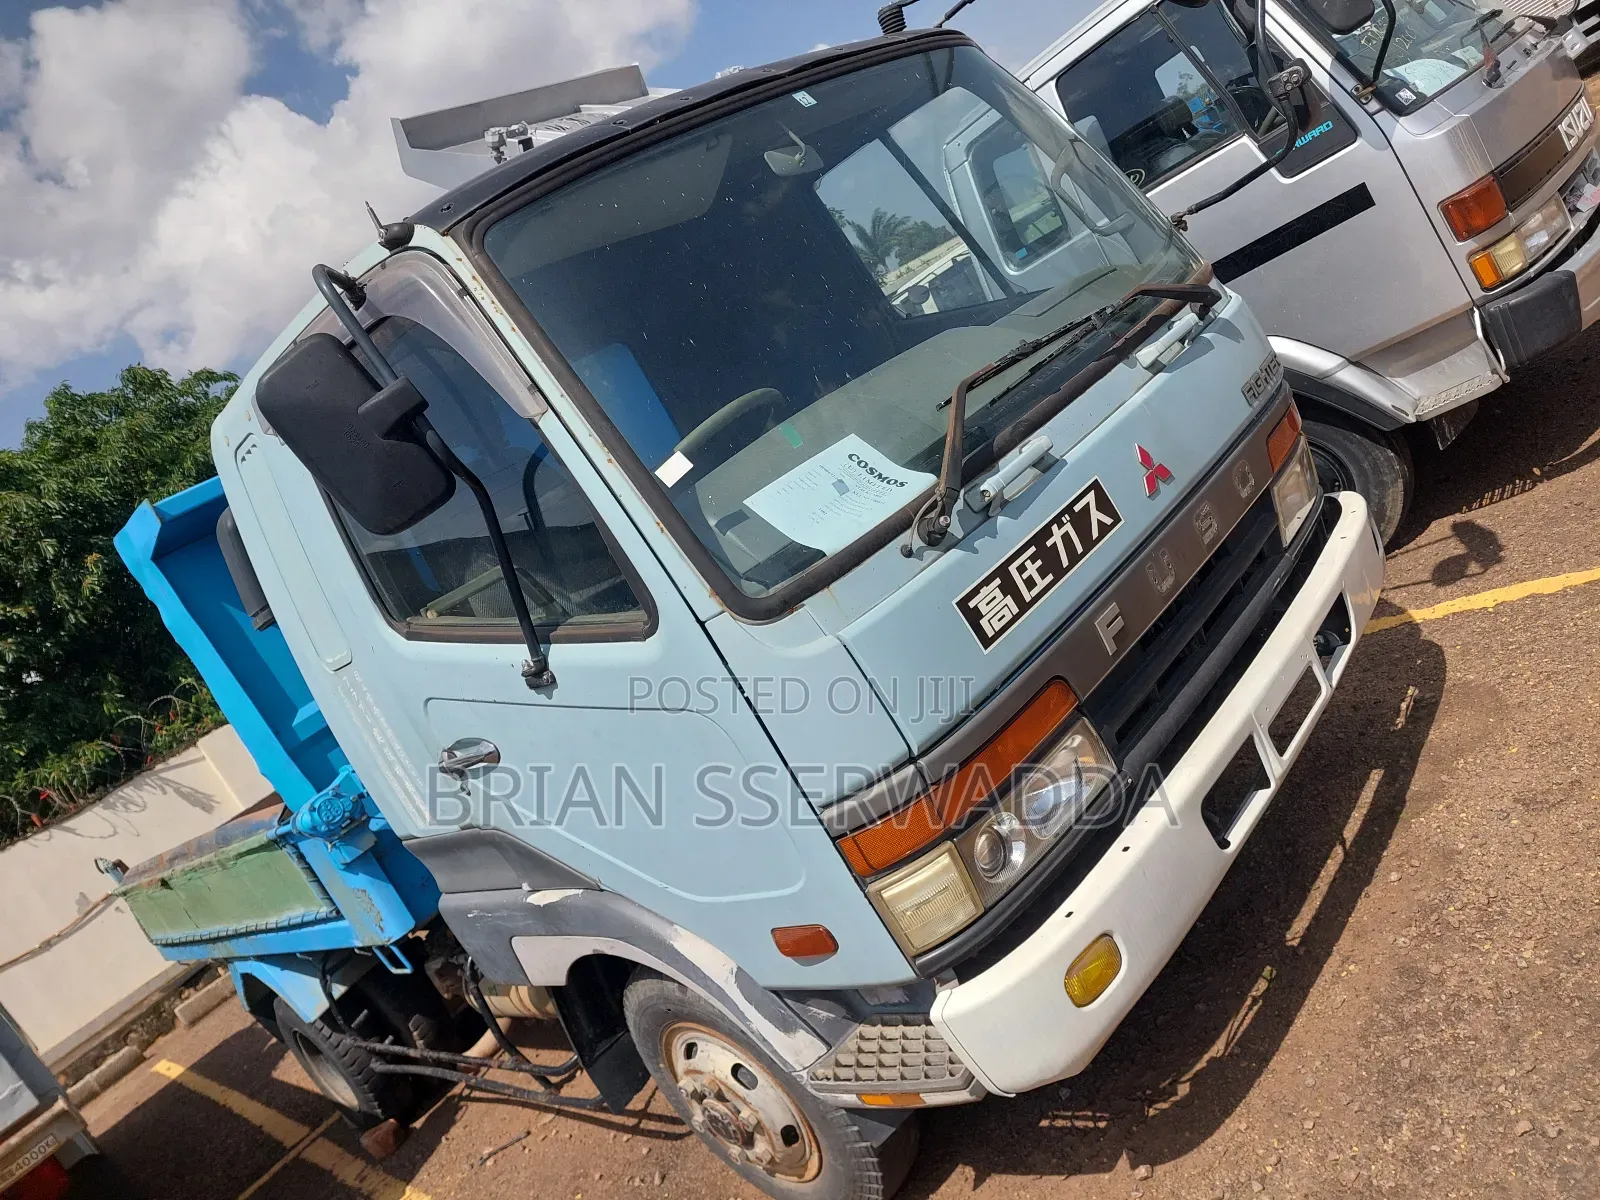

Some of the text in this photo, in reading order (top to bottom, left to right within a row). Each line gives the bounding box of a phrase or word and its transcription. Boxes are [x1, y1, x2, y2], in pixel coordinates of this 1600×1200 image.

[1277, 120, 1333, 155] WARD
[1558, 97, 1595, 151] ISUZU
[848, 453, 908, 488] COSMOS
[968, 489, 1114, 638] 高圧ガス
